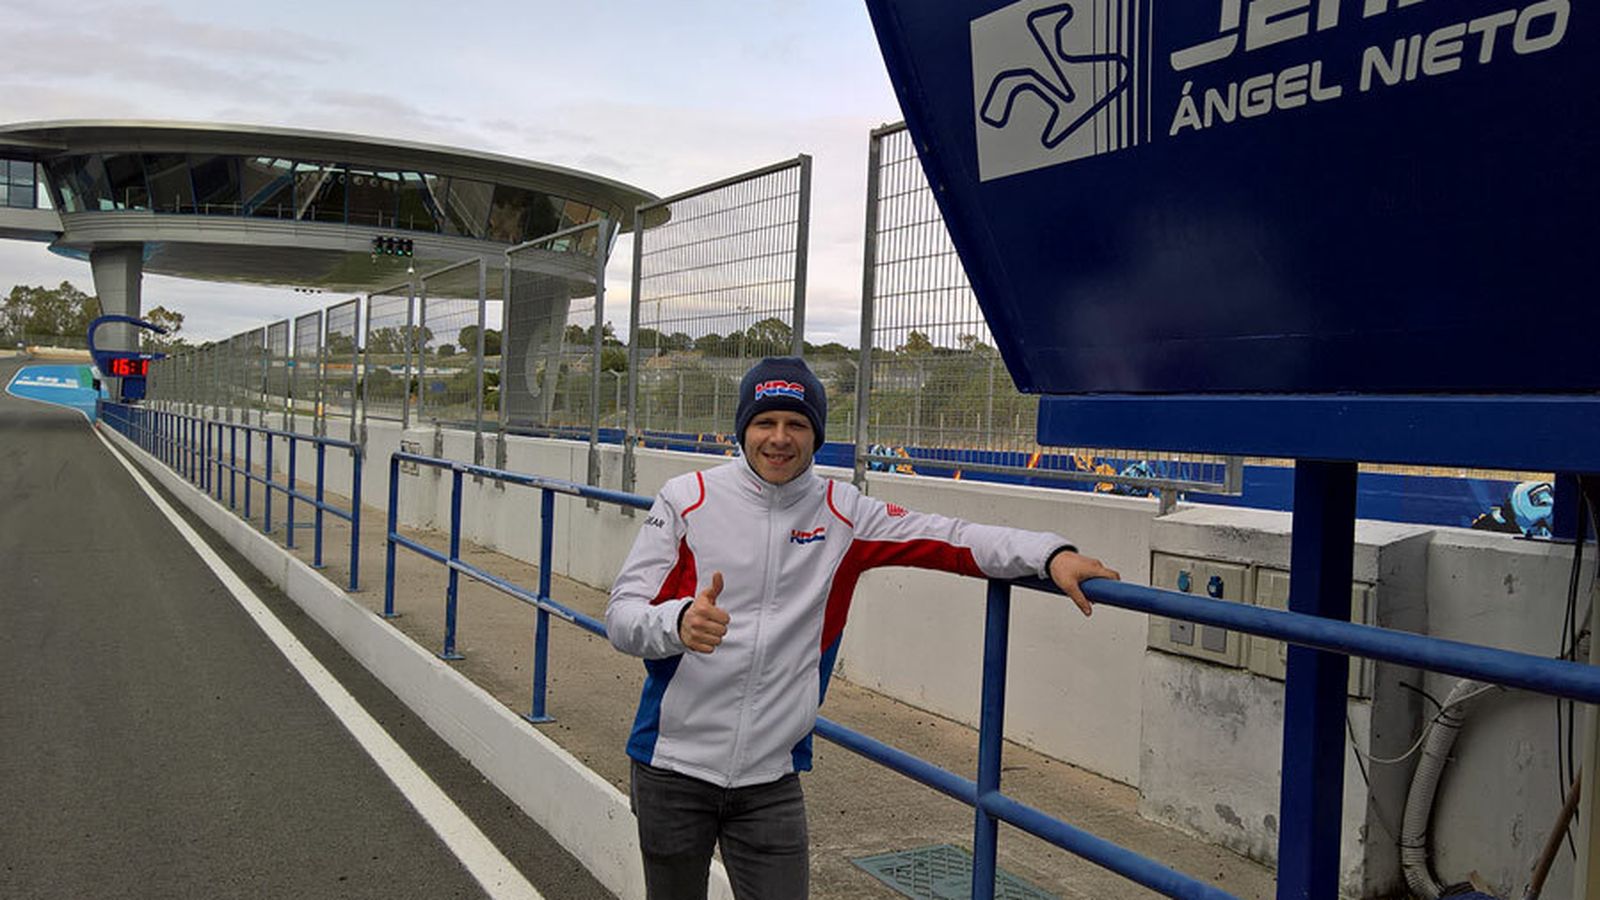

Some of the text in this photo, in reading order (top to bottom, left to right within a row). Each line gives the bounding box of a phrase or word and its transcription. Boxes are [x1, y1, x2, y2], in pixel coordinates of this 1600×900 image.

[1169, 0, 1571, 136] ÁNGEL NIETO
[755, 380, 805, 401] HRC
[790, 527, 826, 545] HRC
